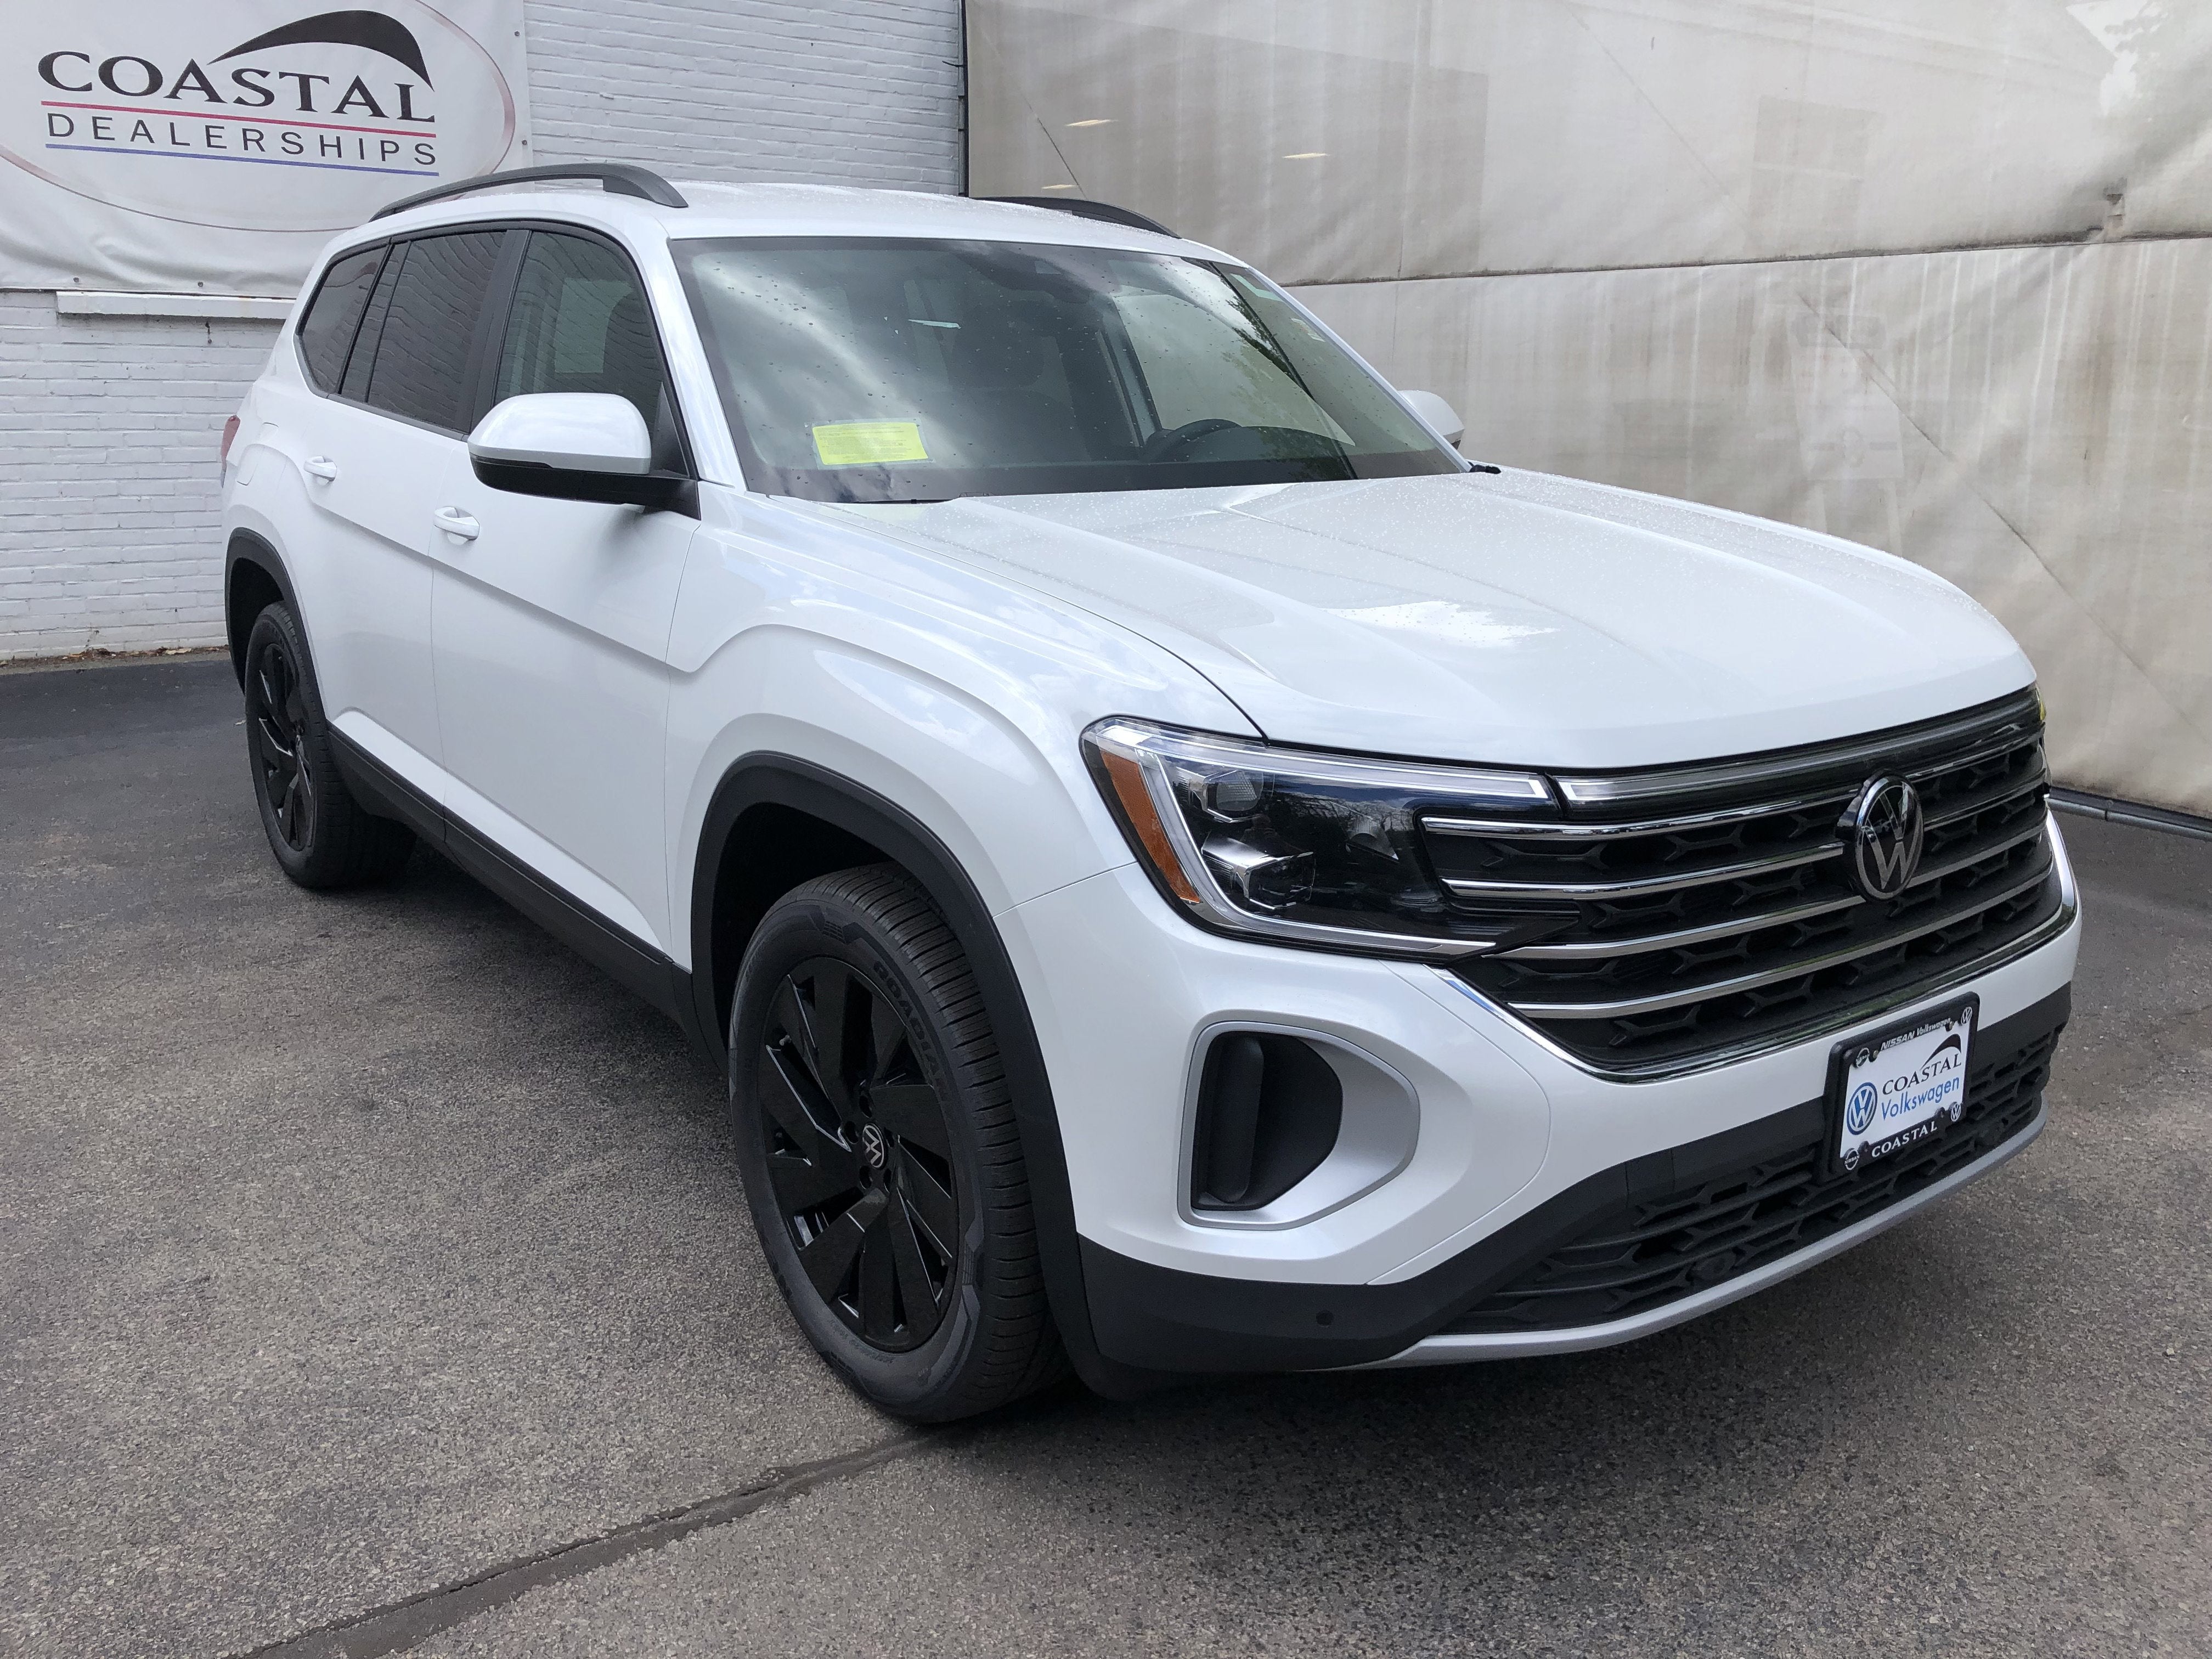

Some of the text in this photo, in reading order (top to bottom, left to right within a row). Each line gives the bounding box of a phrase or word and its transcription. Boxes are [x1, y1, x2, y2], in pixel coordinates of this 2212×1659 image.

[38, 51, 436, 123] COASTAL
[47, 112, 437, 166] DEALERSHIPS
[1880, 1030, 1915, 1051] NISSAN
[1882, 1053, 1962, 1095] COASTAL
[1881, 1076, 1960, 1121] Volkswagen
[1871, 1121, 1937, 1158] COASTAL
